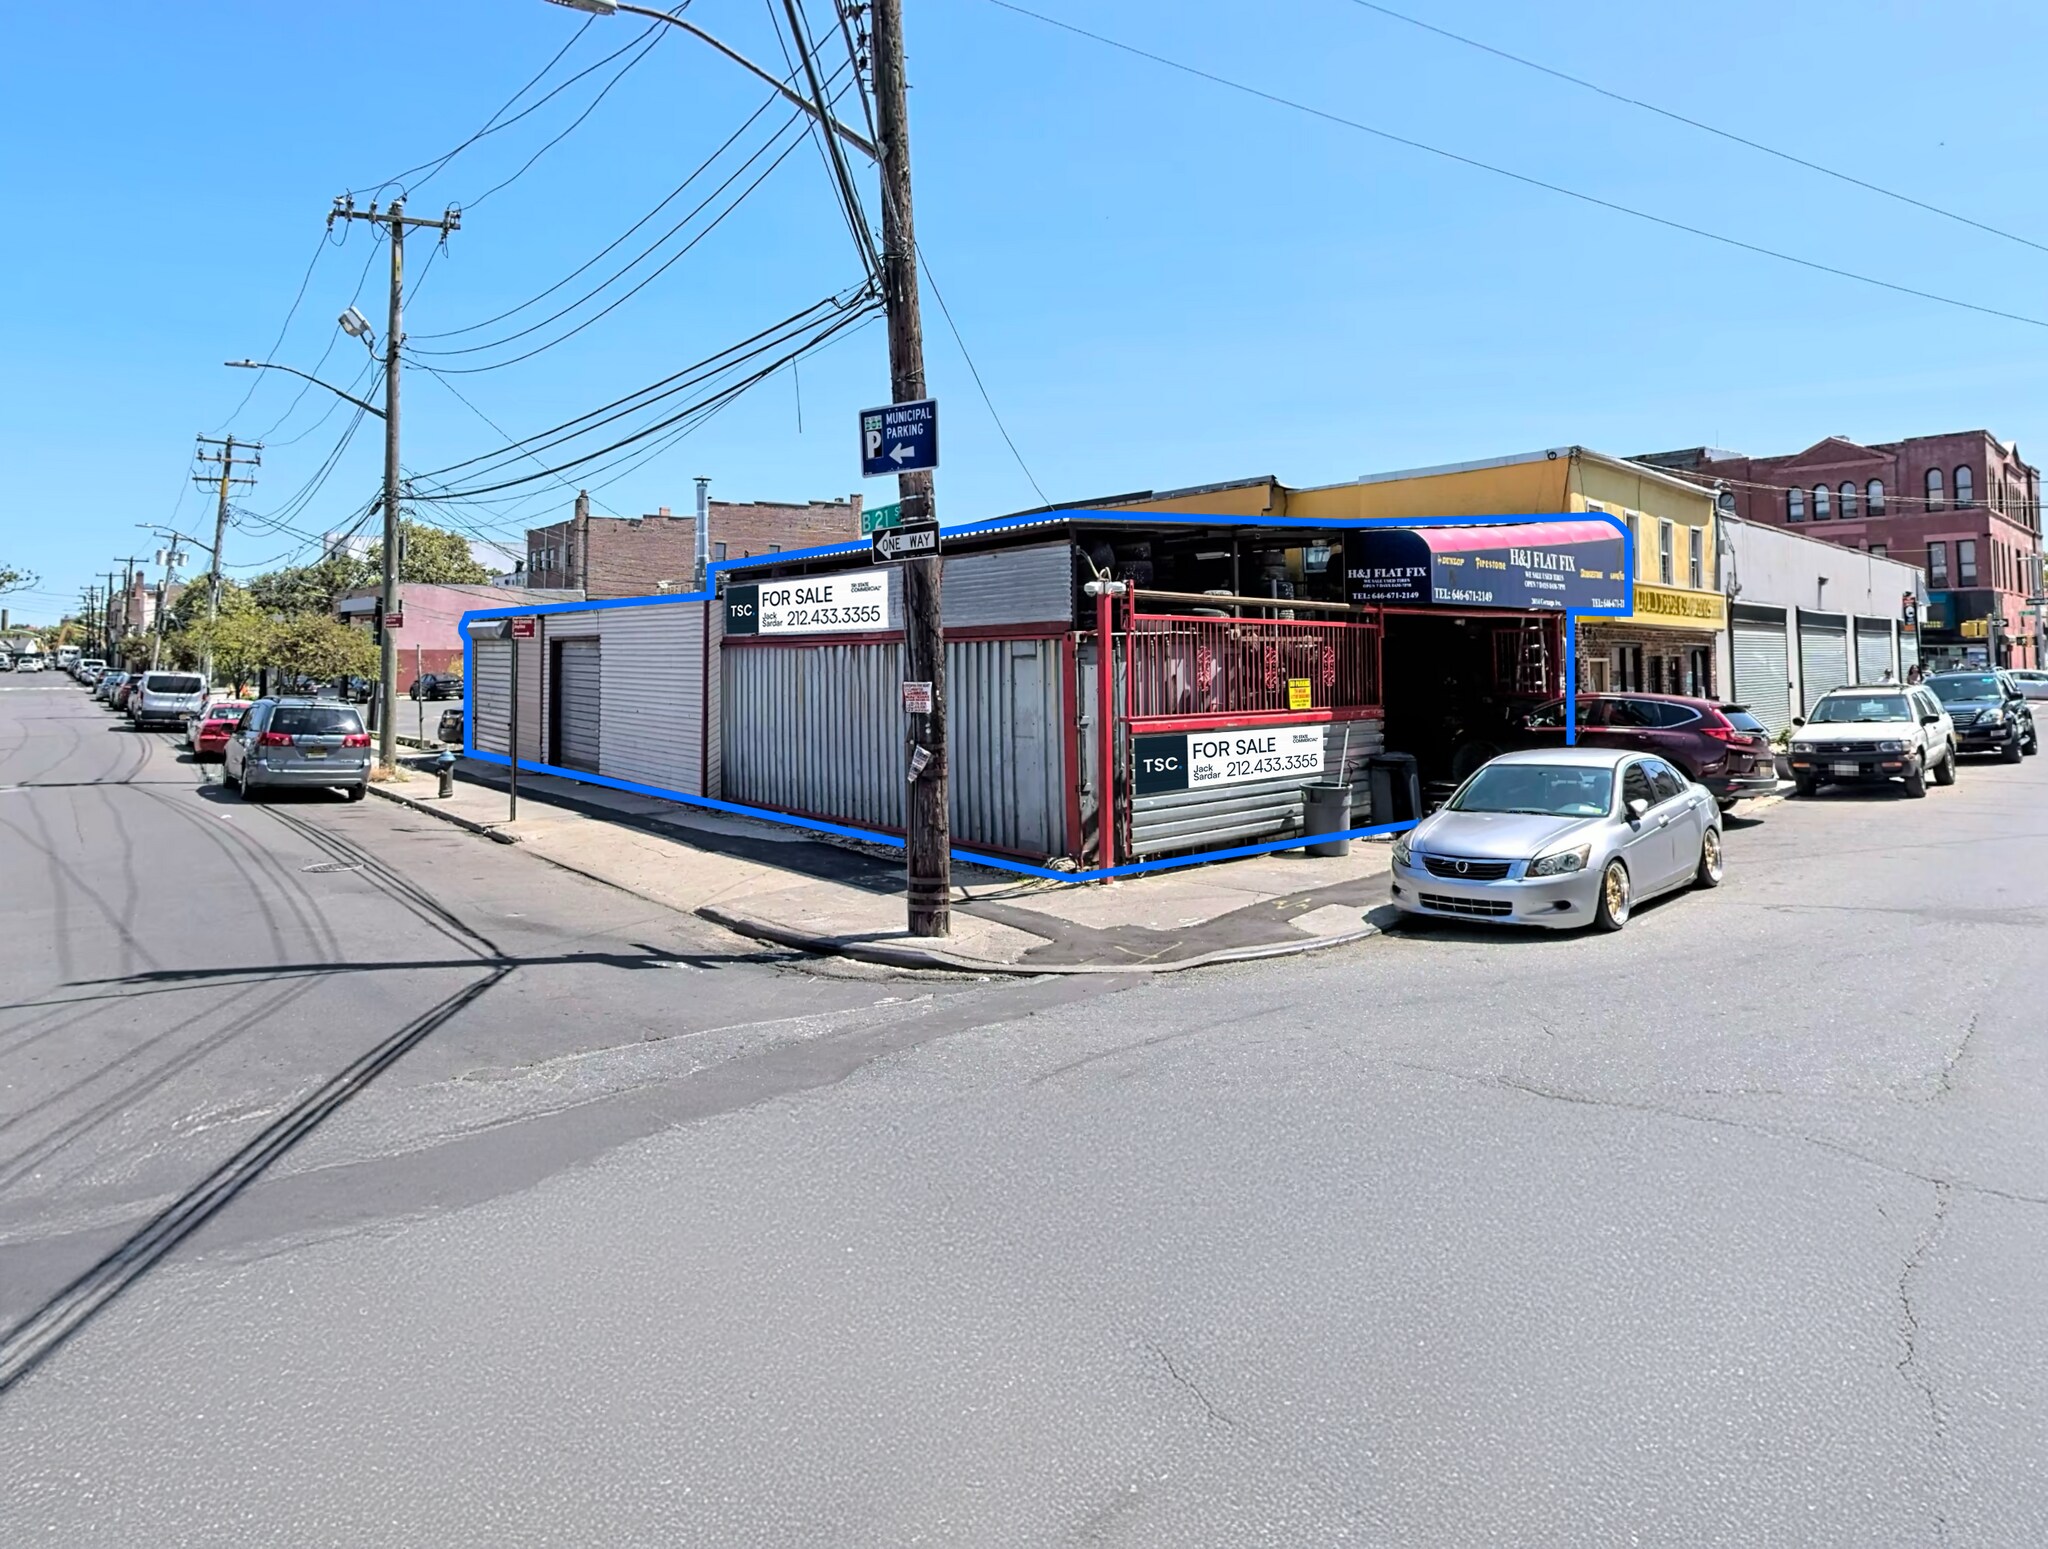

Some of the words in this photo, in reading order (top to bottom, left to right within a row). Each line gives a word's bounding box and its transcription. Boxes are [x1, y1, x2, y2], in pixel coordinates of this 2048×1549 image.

[886, 407, 932, 425] MUNICIPAL
[886, 423, 924, 439] PARKING
[862, 513, 871, 532] B
[875, 510, 889, 529] 21
[882, 537, 901, 552] ONE
[909, 533, 931, 548] WAY
[1509, 548, 1531, 569] H&J
[1533, 551, 1557, 570] FLAT
[1559, 554, 1576, 572] FIX
[1347, 569, 1371, 579] H&J
[1374, 568, 1403, 578] FLAT
[1405, 567, 1427, 577] FIX
[762, 590, 791, 607] FOR
[795, 586, 833, 605] SALE
[1371, 591, 1419, 599] 646-671-2149
[1434, 587, 1451, 600] TEL:
[1451, 589, 1493, 602] 646-671-2149
[762, 612, 777, 620] Jack
[762, 619, 783, 628] Sardar
[787, 605, 881, 626] 212.433.3355
[1193, 741, 1230, 760] FOR
[1235, 737, 1276, 756] SALE
[1193, 764, 1213, 773] Jack
[1226, 753, 1318, 778] 212.433.3355
[1193, 771, 1221, 782] Sardar
